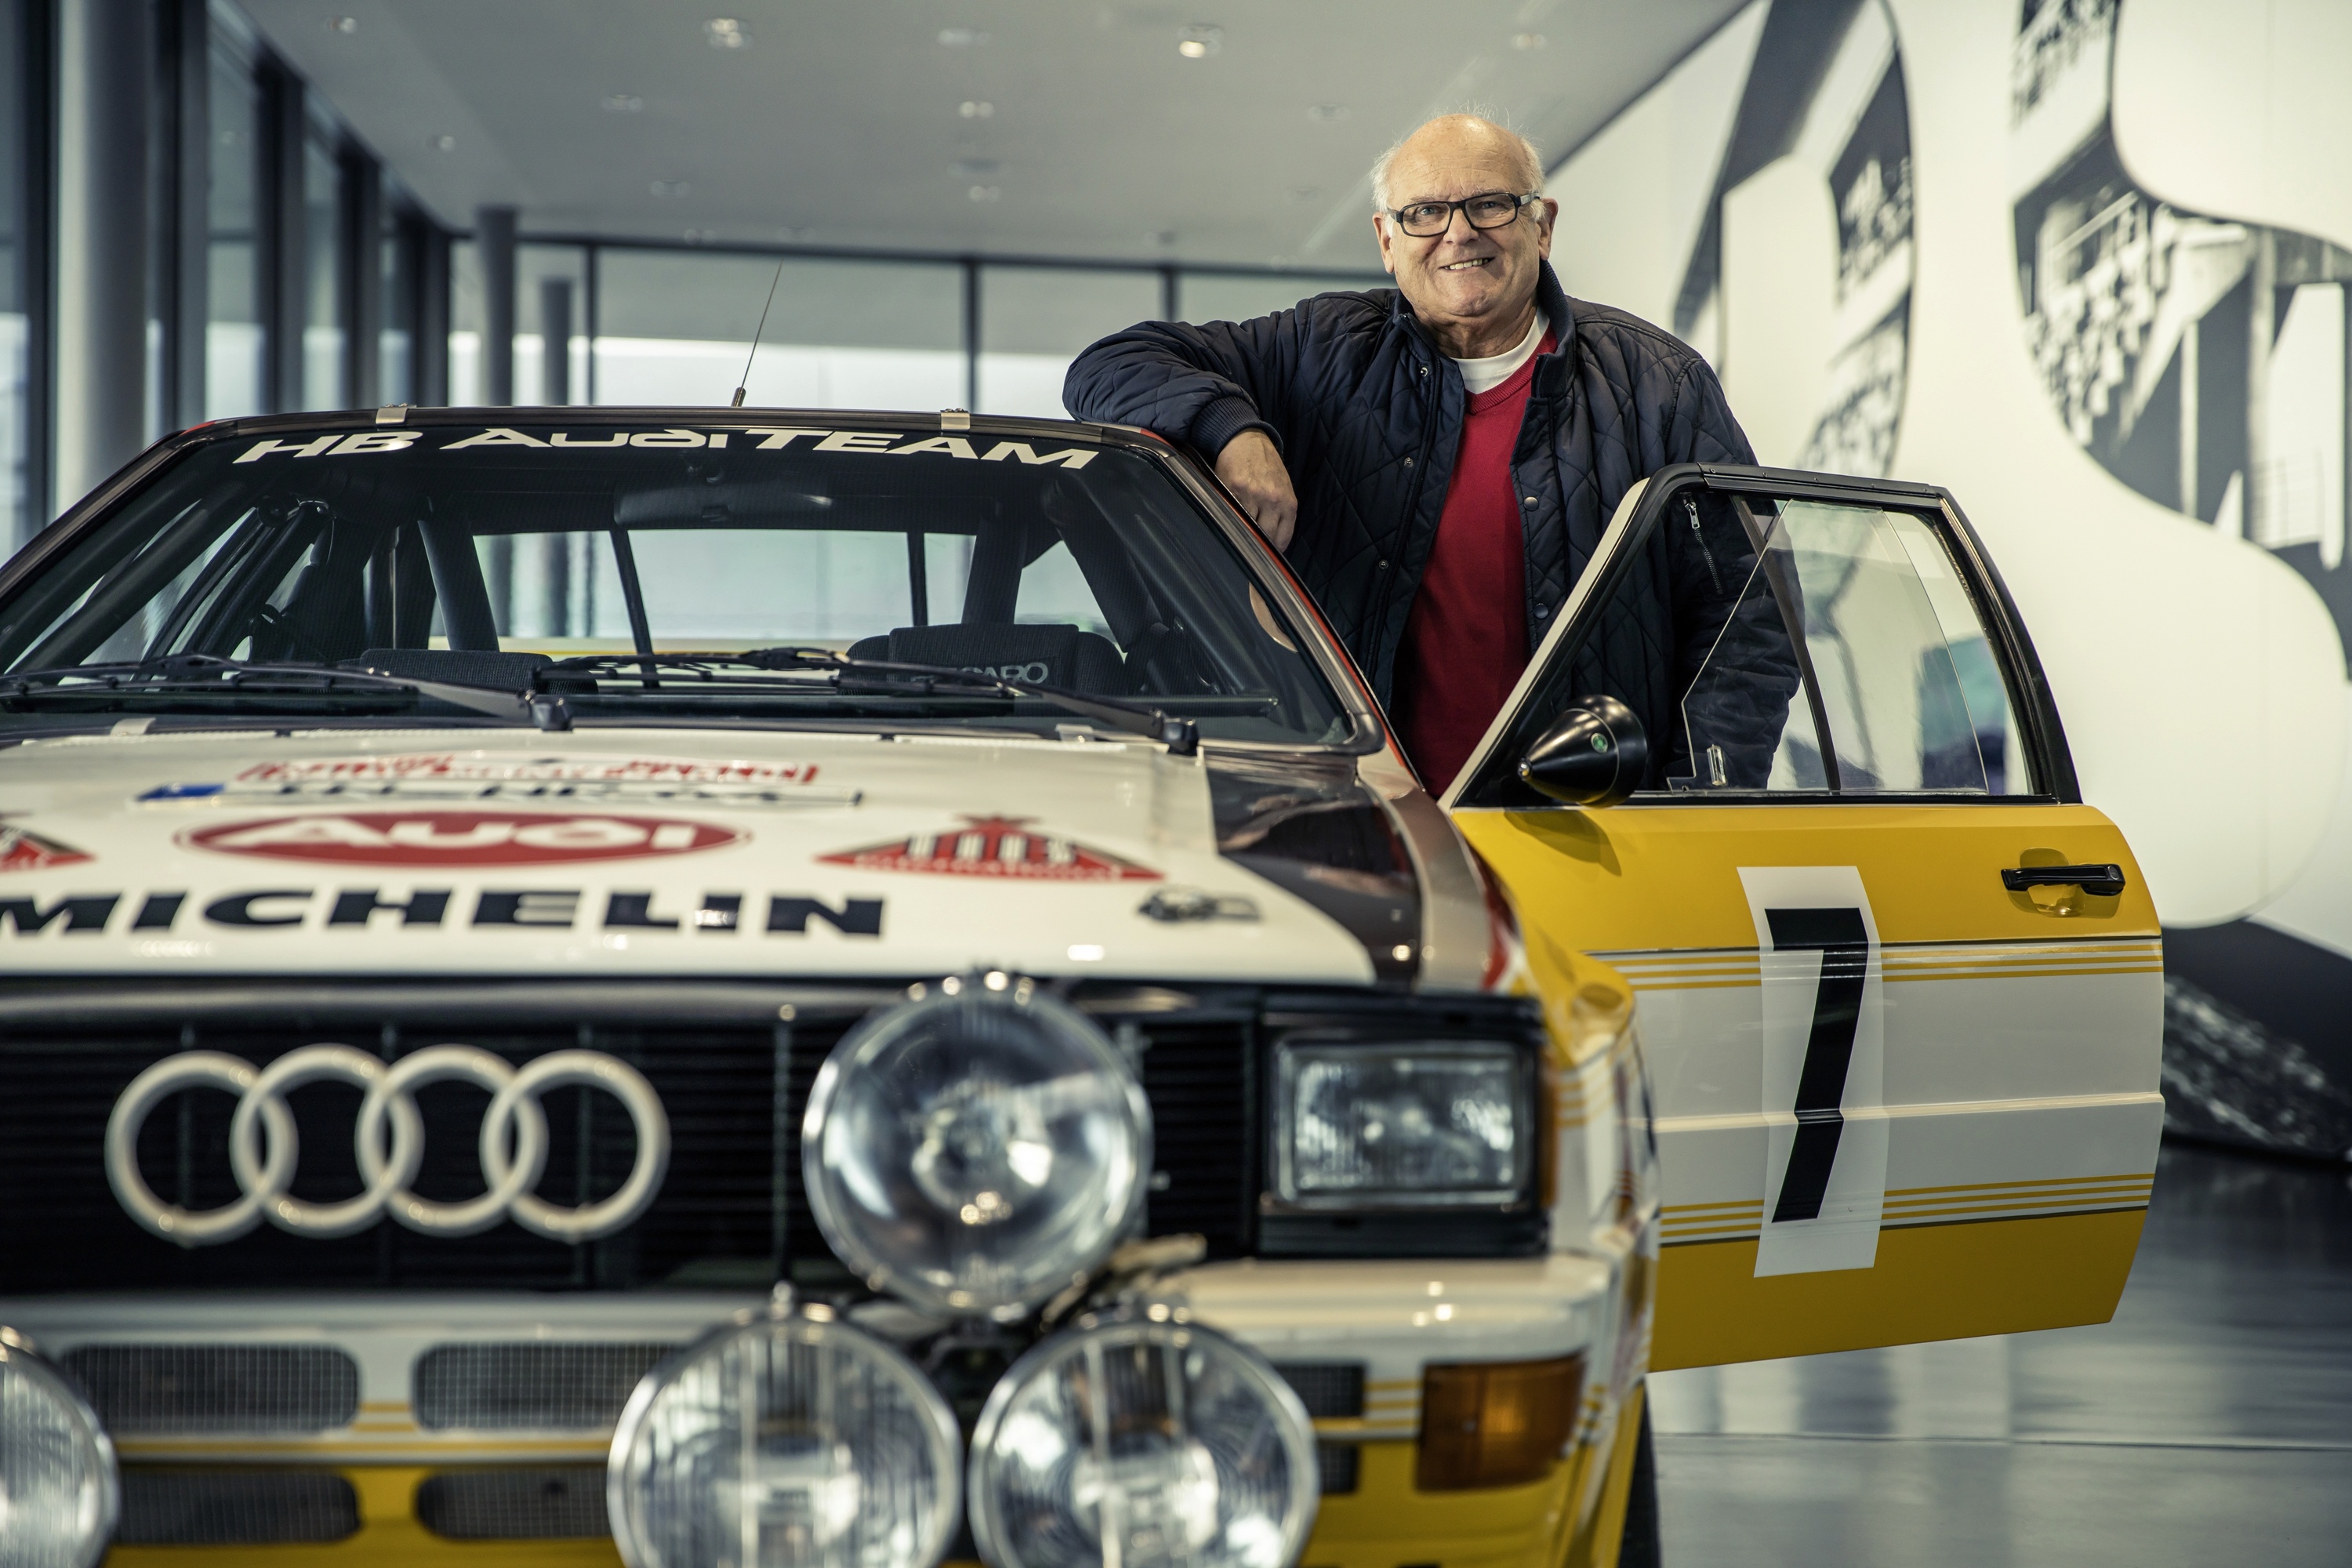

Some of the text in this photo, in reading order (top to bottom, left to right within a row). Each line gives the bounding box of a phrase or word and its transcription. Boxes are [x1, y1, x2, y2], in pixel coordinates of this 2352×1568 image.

[232, 431, 423, 463] HB
[744, 428, 1099, 469] TEAM
[0, 887, 884, 935] MICHELIN
[1764, 907, 1869, 1224] 7
